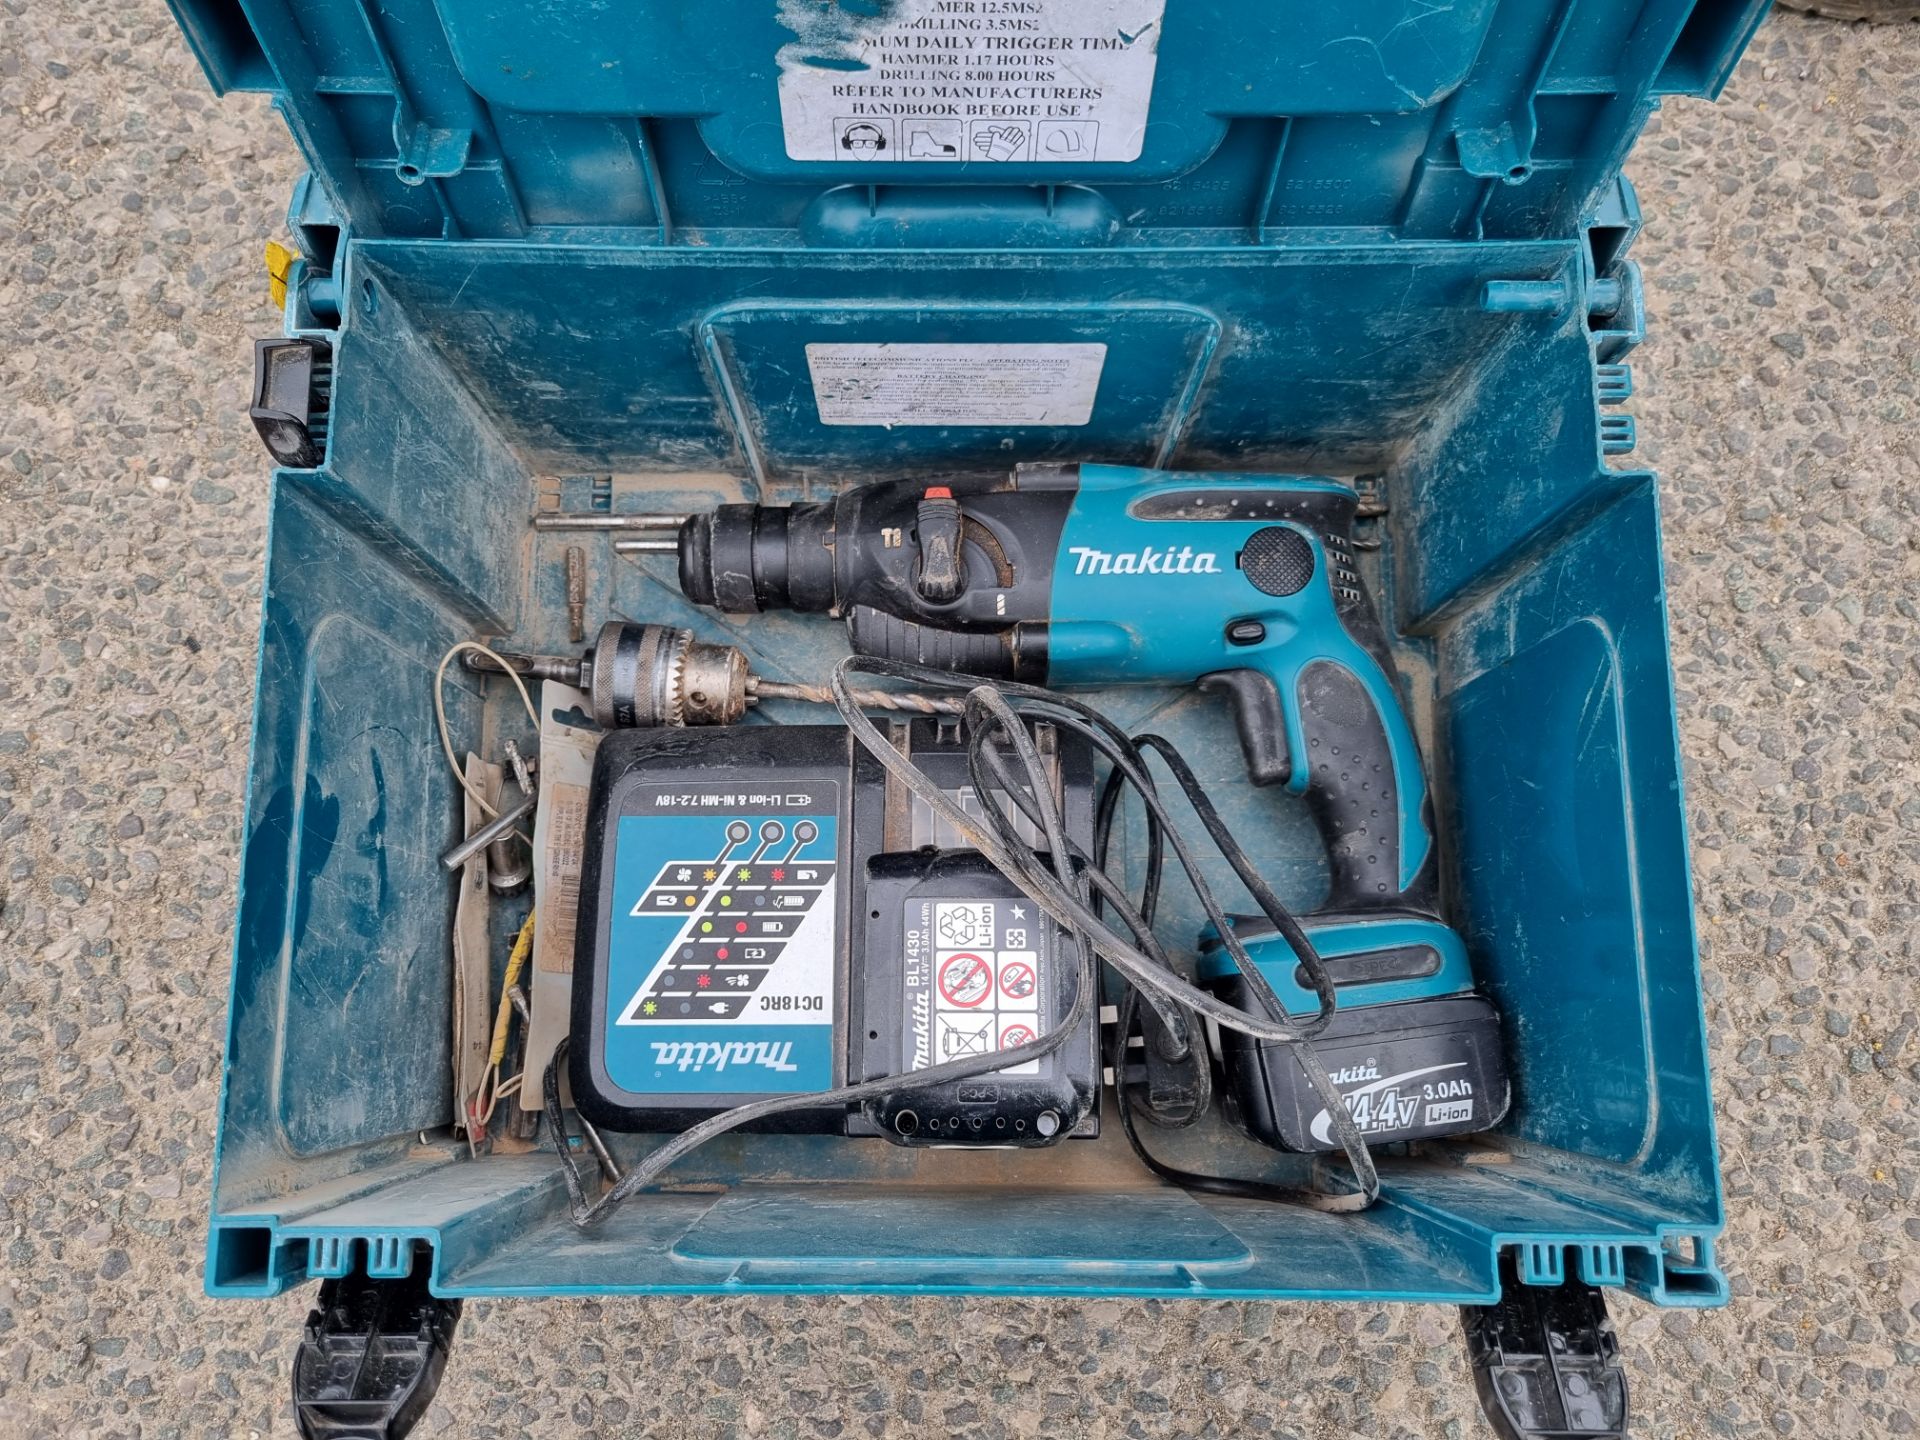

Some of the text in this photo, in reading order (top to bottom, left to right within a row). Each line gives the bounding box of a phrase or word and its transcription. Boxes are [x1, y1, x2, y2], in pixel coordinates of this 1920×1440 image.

[985, 18, 1040, 31] 3.5MS2
[916, 36, 977, 50] DAILY
[982, 36, 1075, 50] TRIGGER
[882, 53, 1054, 66] HAMMER 1.17 HOURS
[880, 69, 1055, 82] DRILLING 8.00 HOURS
[832, 84, 1102, 99] REFER TO MANUFACTURERS
[852, 102, 1081, 117] HANDBOOK BEFORE USE
[1069, 545, 1223, 577] Makita
[655, 793, 782, 808] Li-ion & Ni-MH 7.2-18V
[979, 905, 992, 947] Li-ion
[921, 902, 930, 986] 14.4V 3.0Ah 44Wh
[906, 929, 920, 987] BL1430
[1039, 975, 1048, 1014] Corporation
[760, 995, 823, 1011] DC18RC
[650, 1040, 798, 1073] Makita
[1304, 1065, 1382, 1088] akita
[1423, 1079, 1473, 1101] 3.0Ah
[1428, 1106, 1470, 1122] Li-ion
